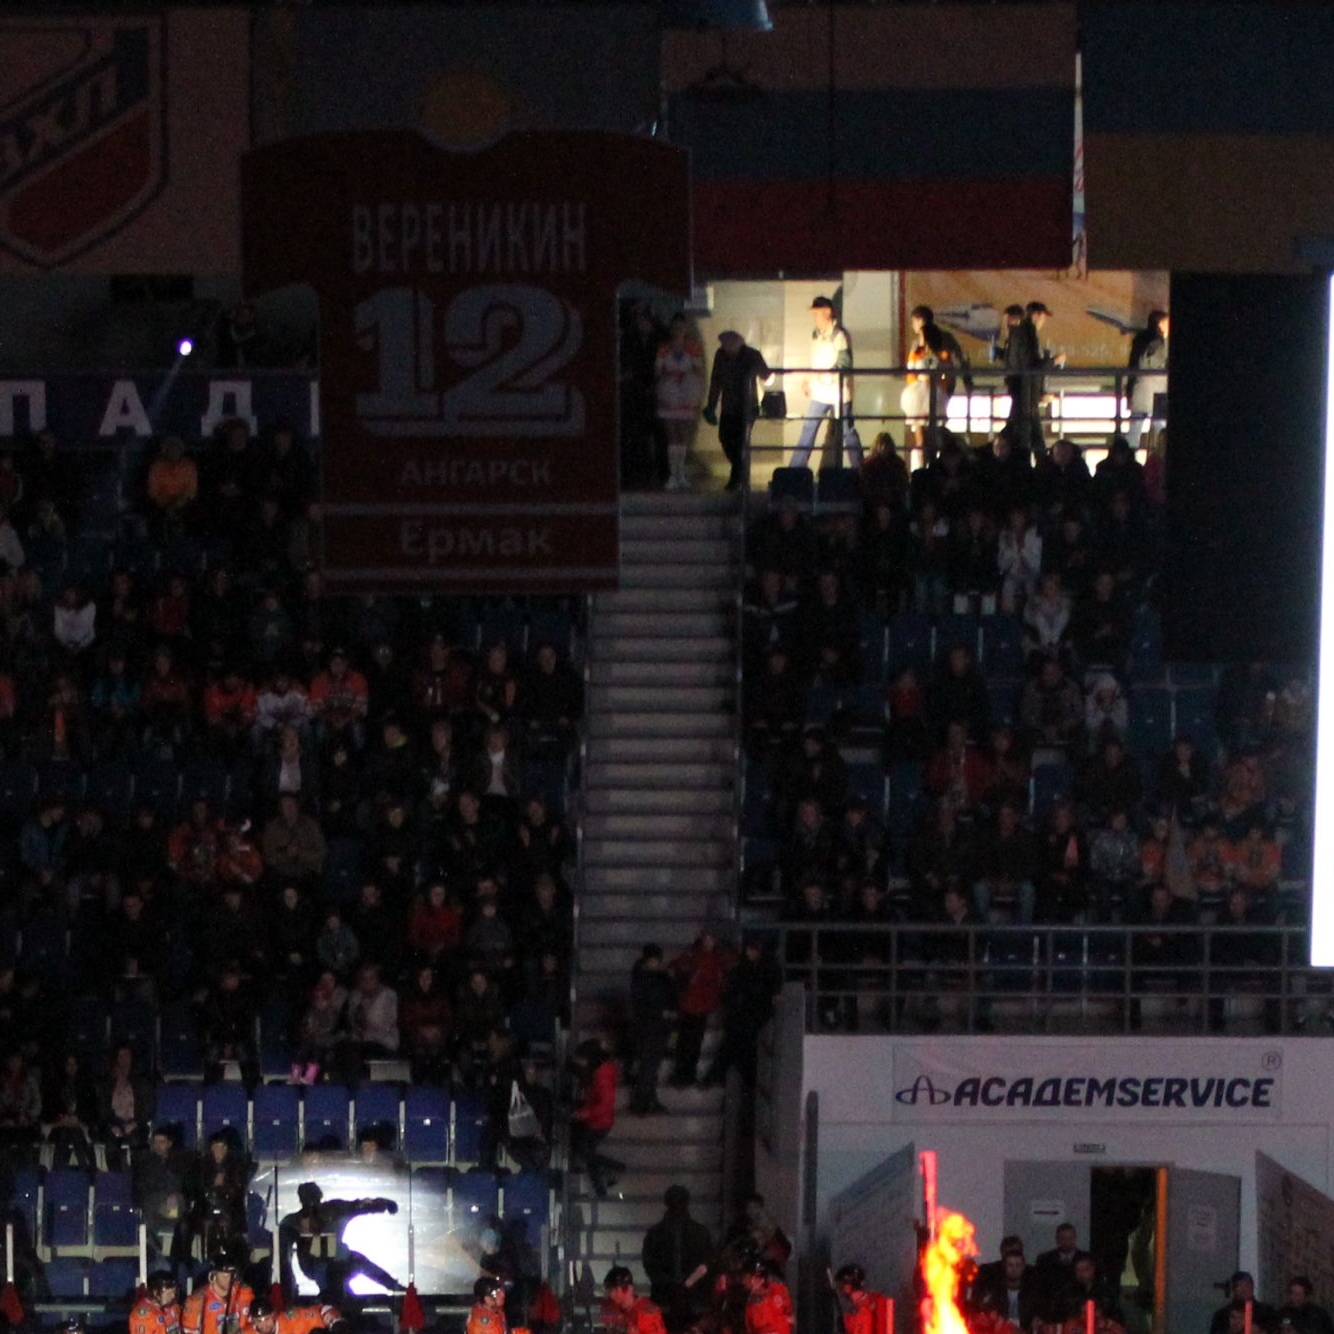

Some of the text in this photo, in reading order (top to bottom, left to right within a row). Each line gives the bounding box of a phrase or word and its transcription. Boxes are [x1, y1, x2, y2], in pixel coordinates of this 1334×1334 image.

[353, 203, 586, 272] ВЕРЕНИКИН
[354, 283, 586, 438] 12
[401, 459, 553, 487] АНГАРСК
[400, 519, 553, 562] Ермак
